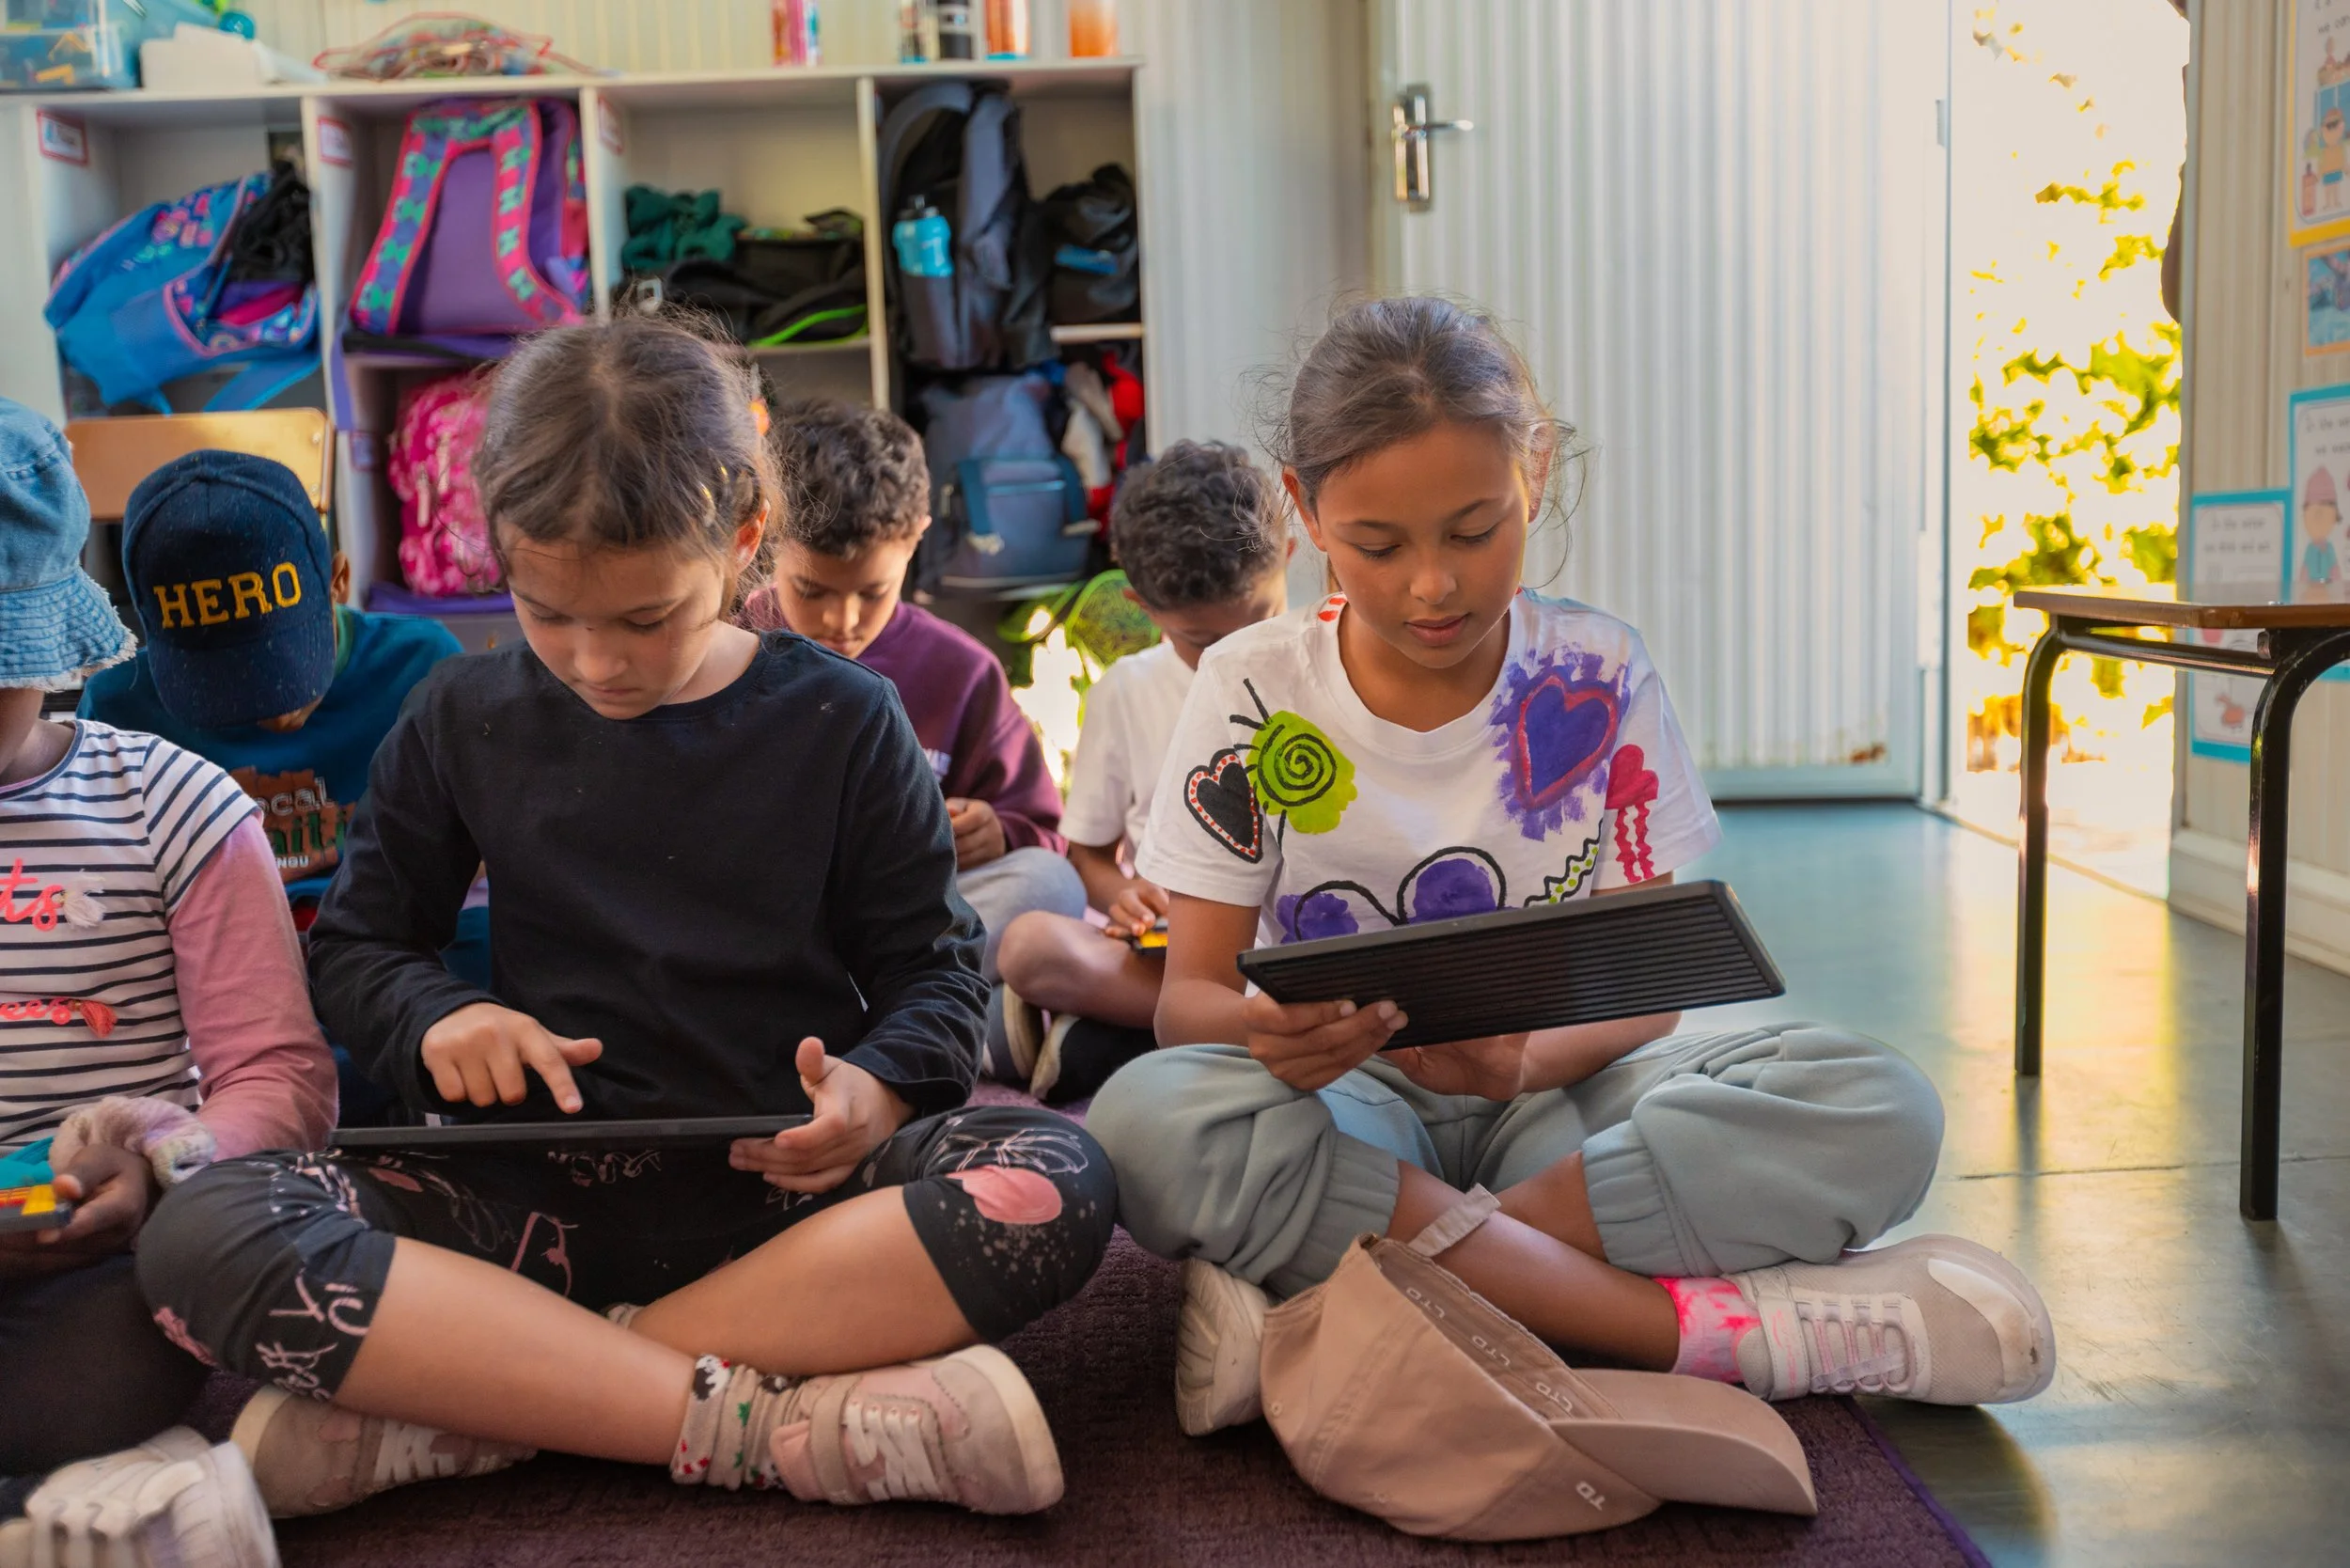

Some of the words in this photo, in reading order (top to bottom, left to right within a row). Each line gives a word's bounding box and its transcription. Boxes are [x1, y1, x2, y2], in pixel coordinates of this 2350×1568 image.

[153, 561, 302, 629] HERO
[1406, 1287, 1445, 1320] LTD
[1471, 1334, 1511, 1367] LTD
[1535, 1381, 1574, 1412] LTD
